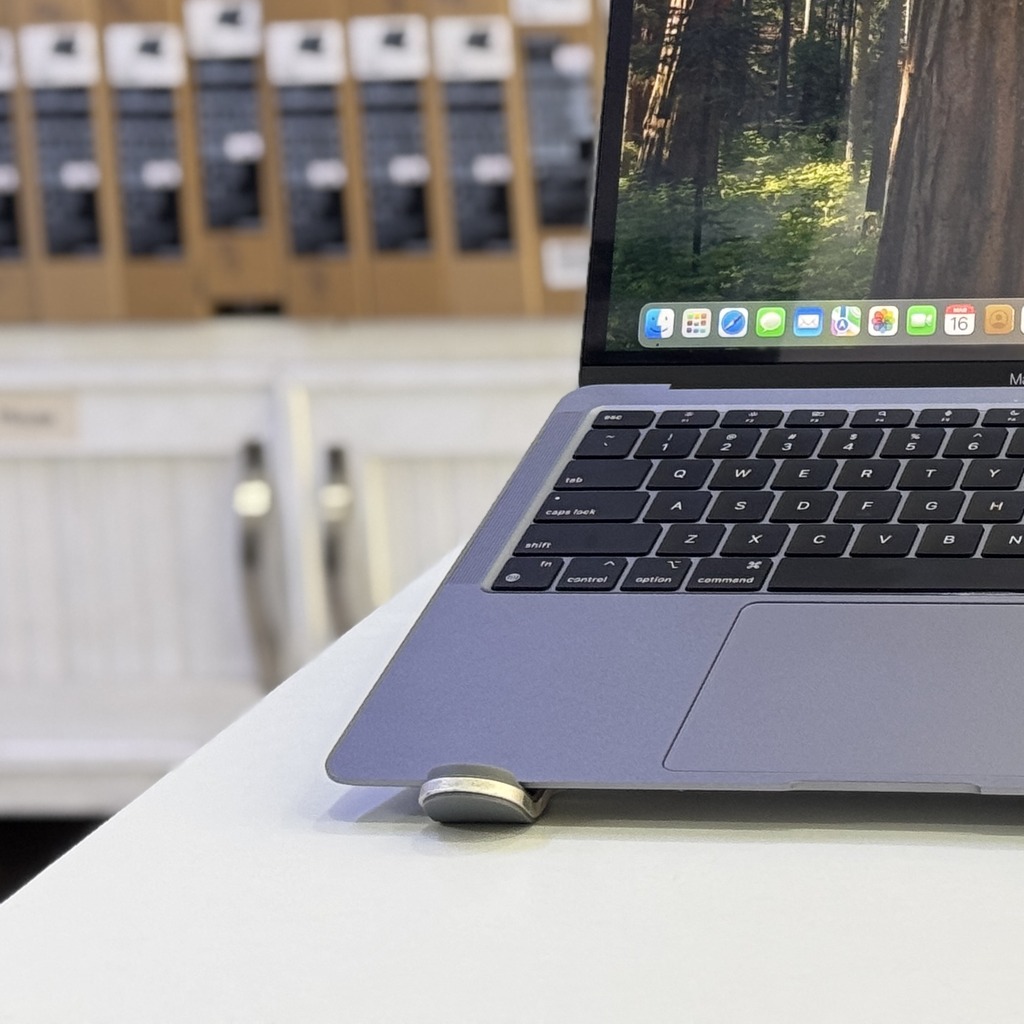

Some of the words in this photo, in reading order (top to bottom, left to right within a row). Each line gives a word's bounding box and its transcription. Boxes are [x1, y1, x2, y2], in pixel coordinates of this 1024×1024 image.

[950, 316, 969, 331] 16
[603, 414, 624, 422] esc
[662, 443, 669, 451] 1
[720, 442, 732, 451] 2
[781, 442, 793, 451] 3
[842, 442, 854, 451] 4
[905, 442, 917, 451] 5
[967, 442, 979, 451] 6
[673, 469, 687, 479] Q
[735, 469, 752, 478] W
[798, 469, 810, 478] E
[860, 469, 873, 478] R
[926, 469, 937, 478] T
[989, 469, 1001, 478] Y
[565, 476, 583, 484] tab
[670, 501, 682, 511] A
[734, 501, 747, 511] S
[796, 501, 810, 511] D
[861, 501, 874, 510] F
[925, 501, 938, 511] G
[989, 501, 1004, 511] H
[684, 534, 698, 544] Z
[748, 534, 763, 544] X
[813, 534, 826, 544] C
[879, 534, 892, 544] V
[943, 535, 955, 544] B
[1008, 535, 1023, 545] N
[635, 576, 672, 584] option
